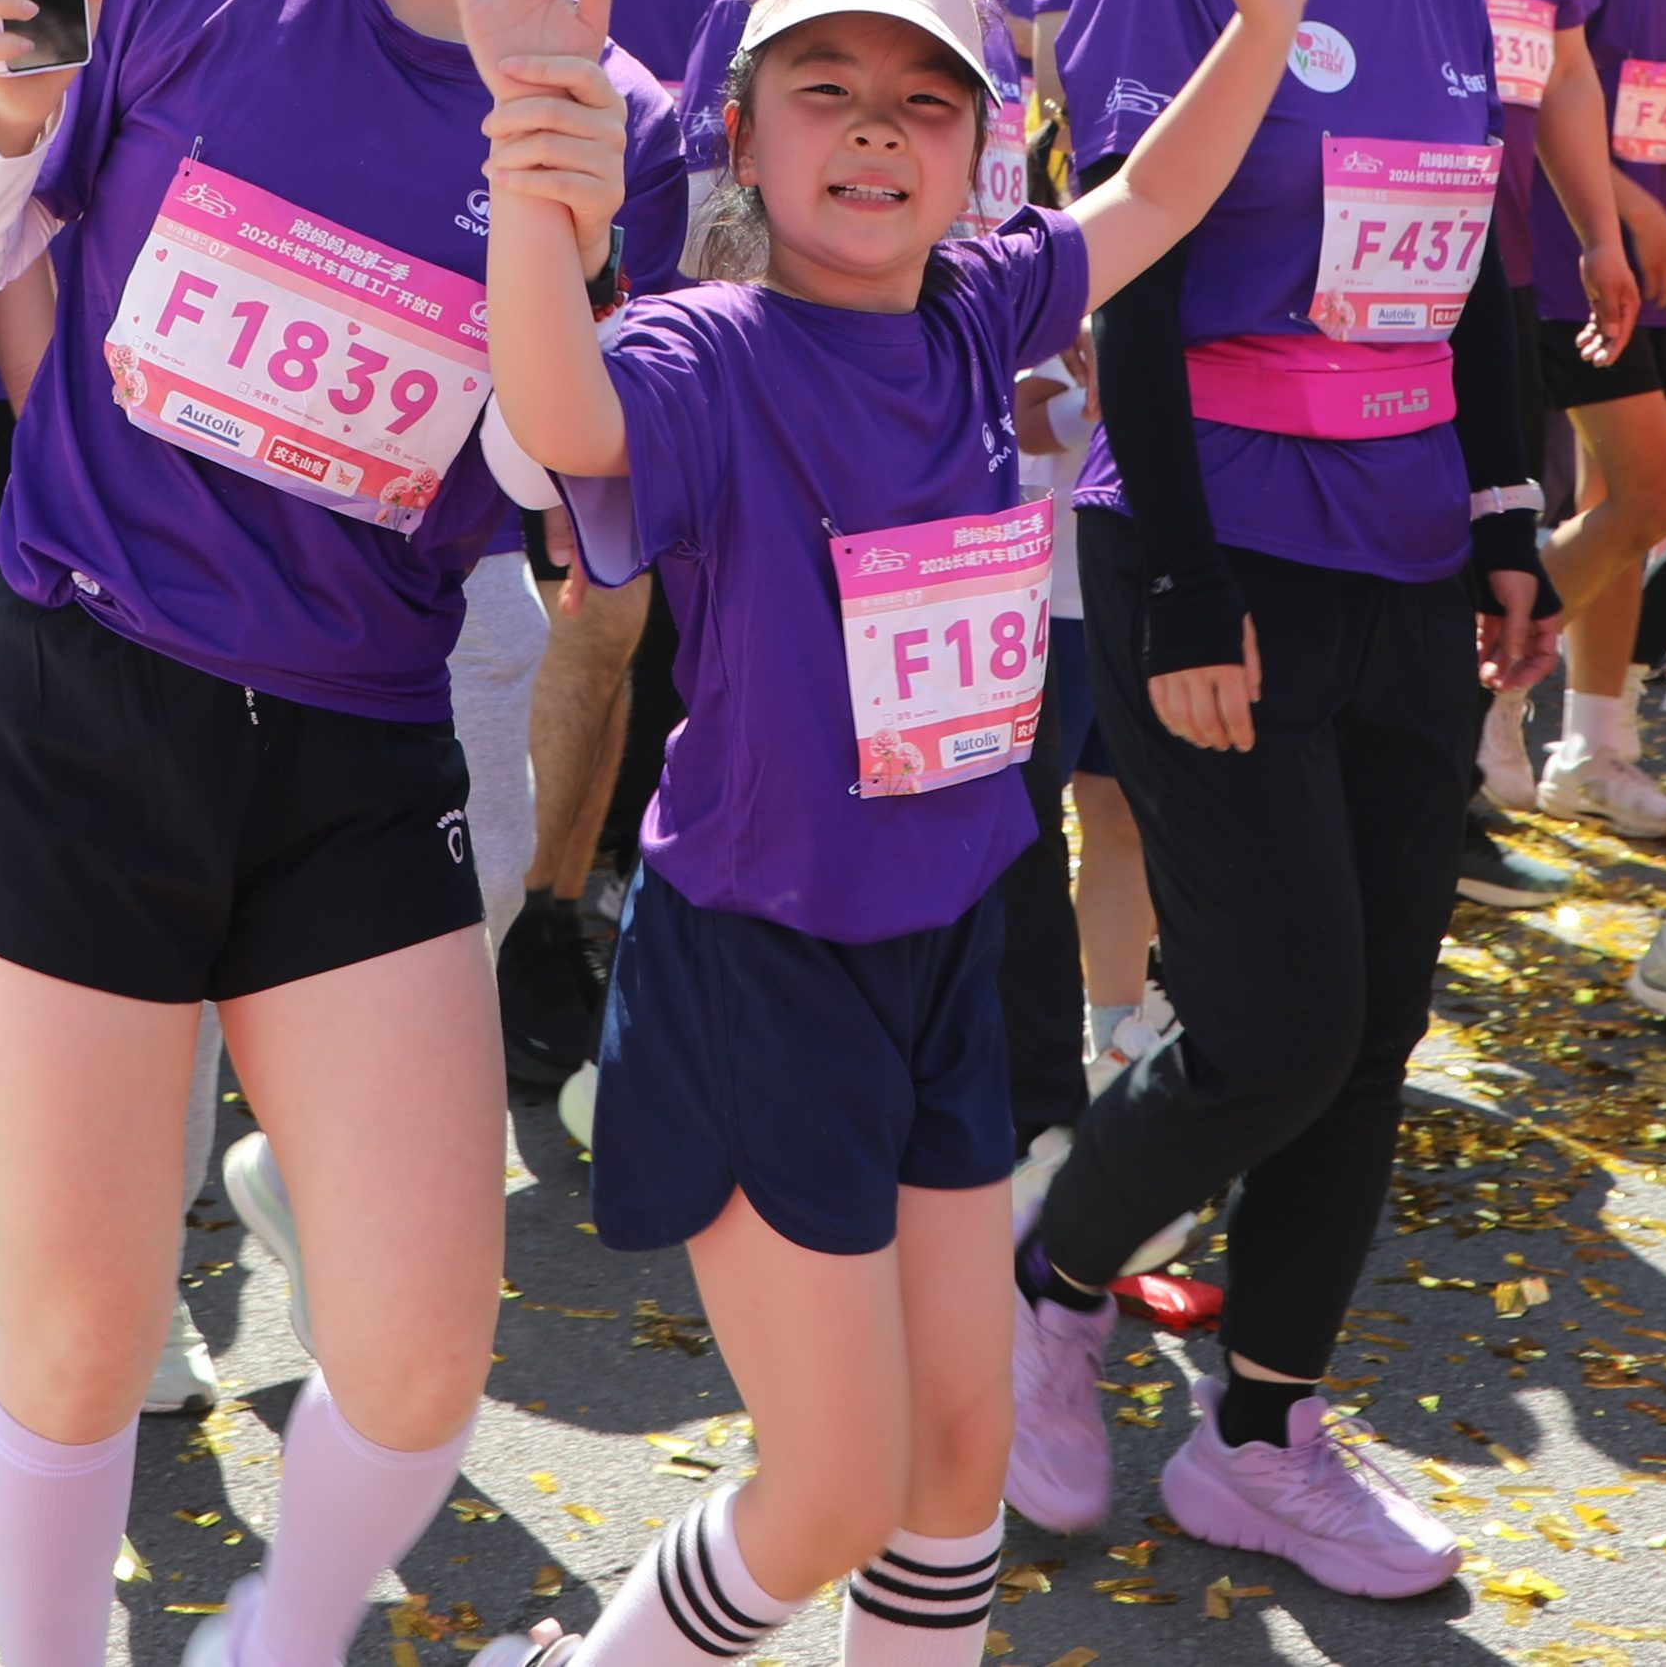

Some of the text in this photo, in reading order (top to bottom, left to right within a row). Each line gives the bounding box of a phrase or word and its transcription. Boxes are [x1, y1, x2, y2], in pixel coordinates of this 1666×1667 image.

[454, 214, 489, 236] GW
[208, 242, 231, 259] 07
[288, 218, 411, 282] 陪妈妈跑第二季
[1351, 221, 1487, 272] F437
[237, 222, 445, 322] 2026长城汽车智慧工厂开放日
[1378, 309, 1417, 321] Autoliv
[154, 269, 439, 436] F1839
[180, 403, 246, 439] Autoliv
[273, 445, 327, 478] 农夫山泉
[952, 733, 1001, 755] Autoliv
